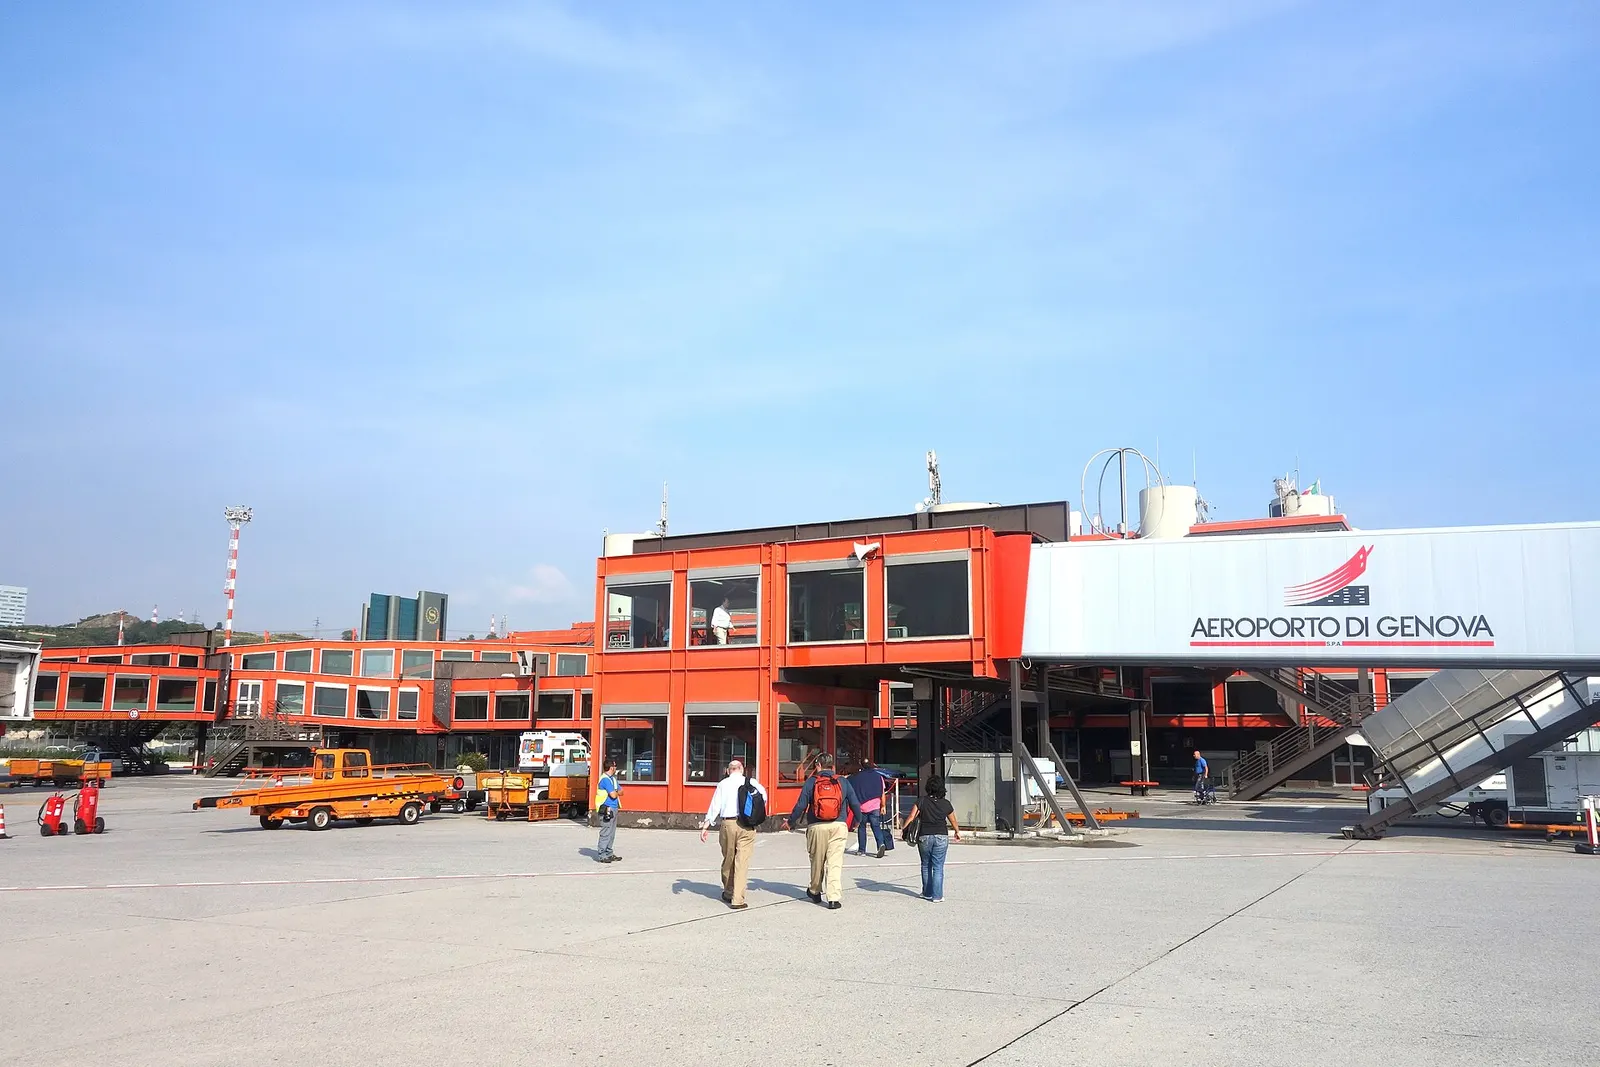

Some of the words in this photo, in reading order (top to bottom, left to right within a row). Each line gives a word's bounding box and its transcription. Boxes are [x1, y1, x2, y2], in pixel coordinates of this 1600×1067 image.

[1190, 616, 1341, 638] AEROPORTO
[1345, 616, 1369, 638] DI
[1376, 614, 1495, 638] GENOVA
